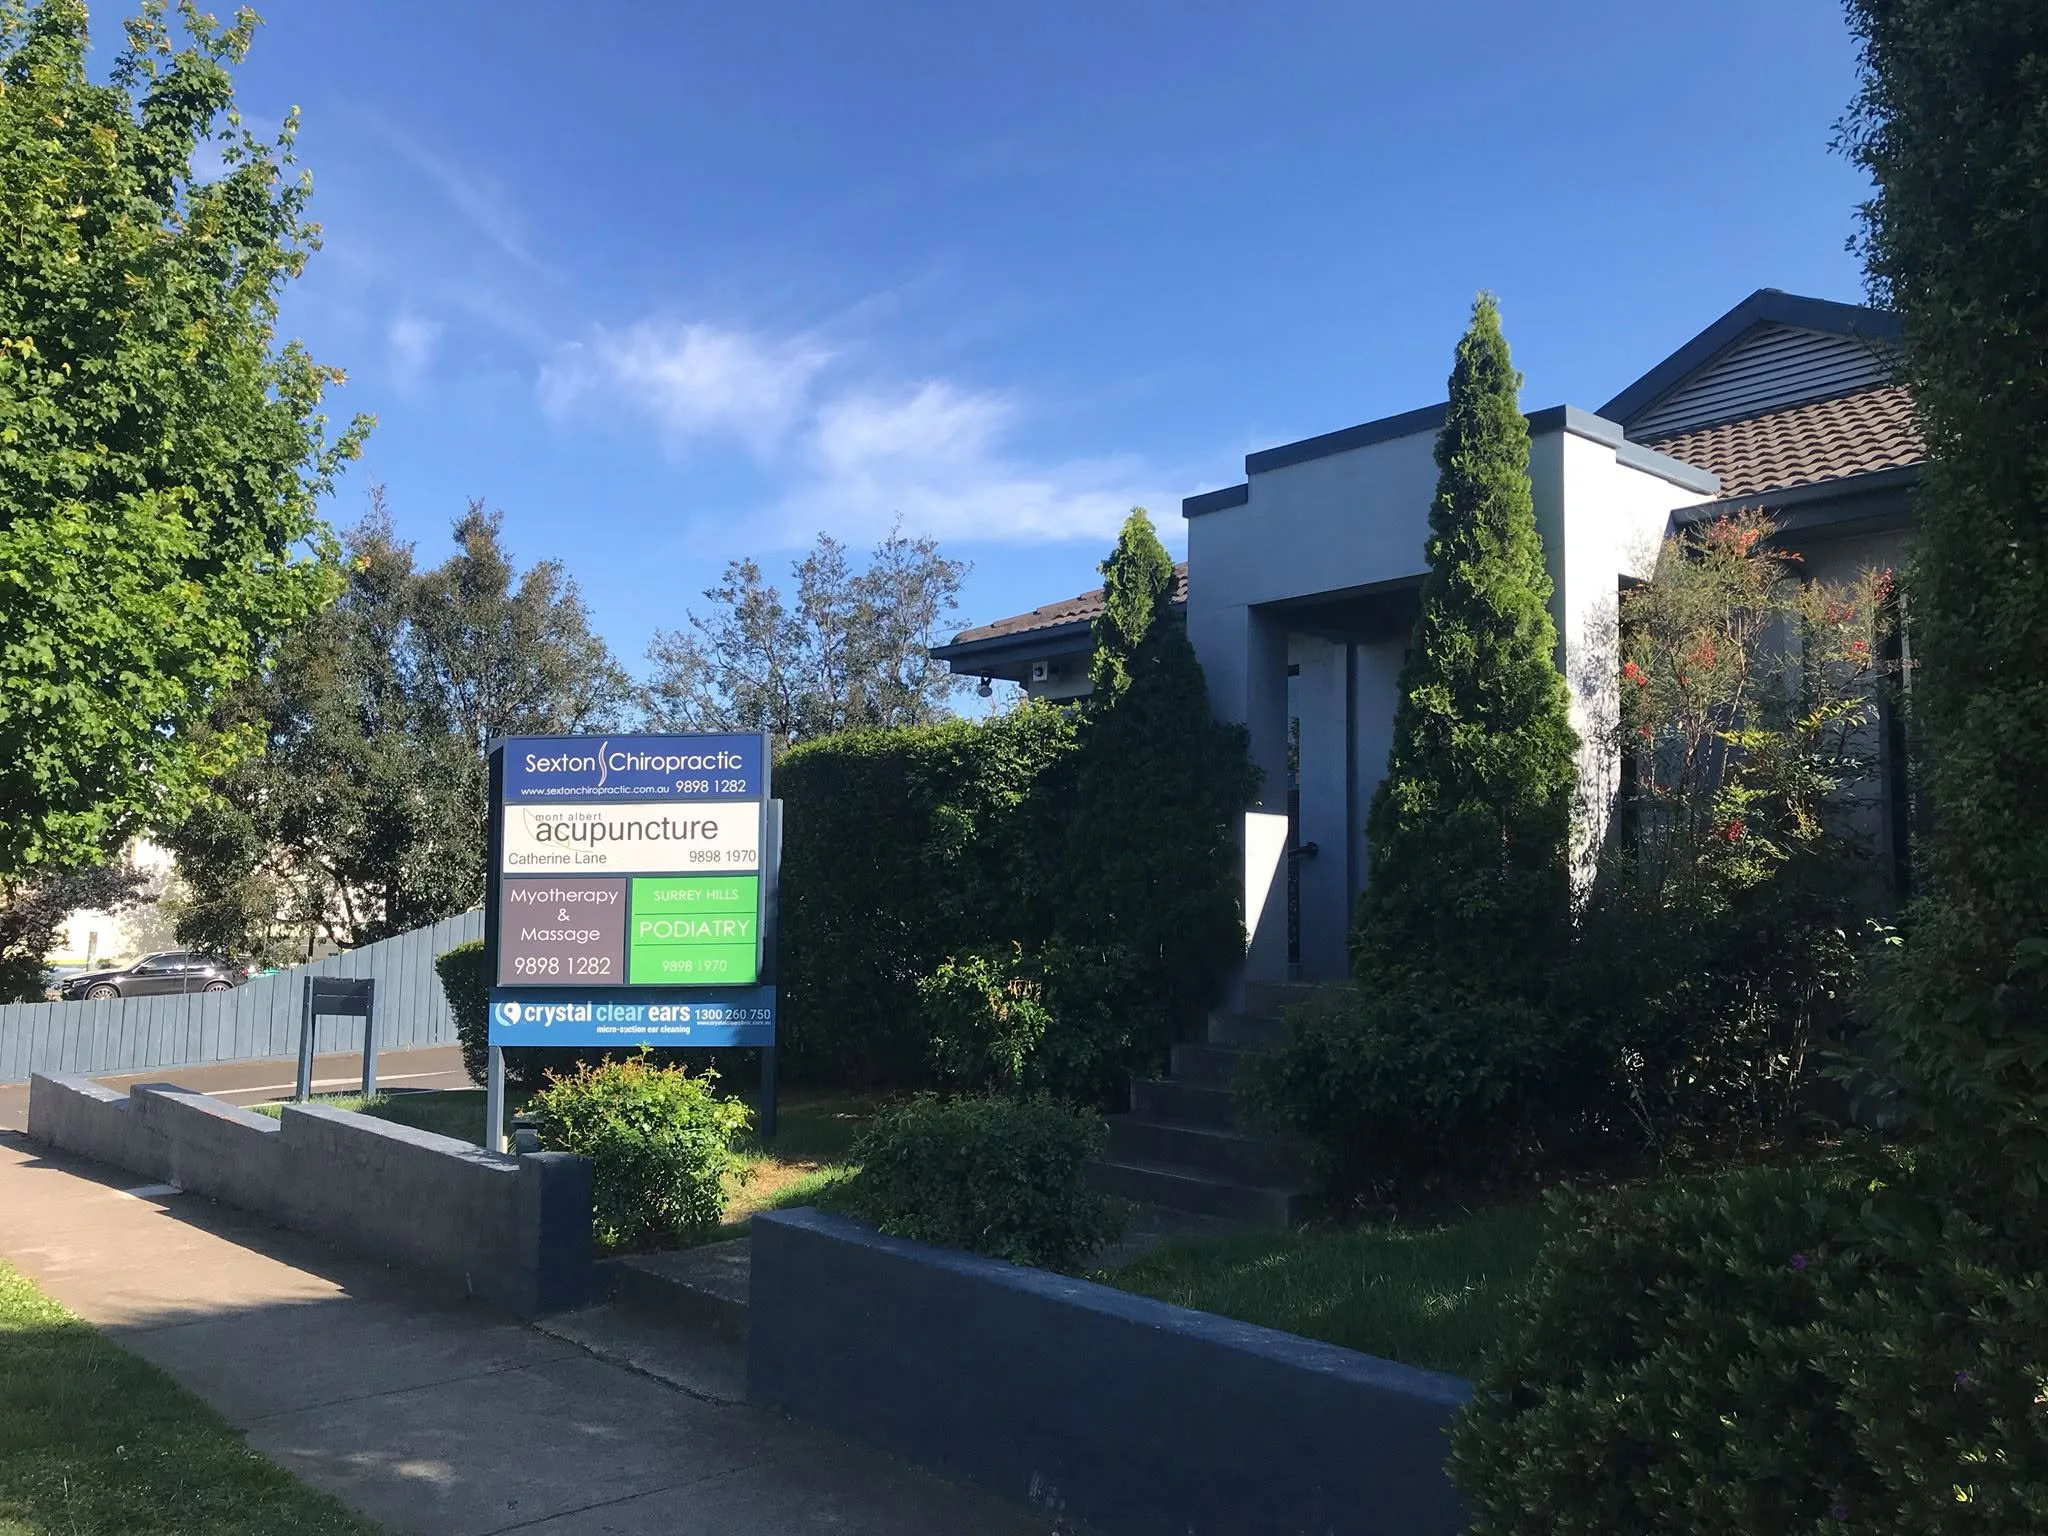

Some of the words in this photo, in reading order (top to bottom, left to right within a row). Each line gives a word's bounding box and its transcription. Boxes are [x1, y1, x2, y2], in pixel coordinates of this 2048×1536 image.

[525, 754, 595, 772] Sexton
[608, 750, 742, 774] Chiropractic
[521, 786, 670, 795] www.sextonchiropractic.com.au
[675, 780, 709, 793] 9898
[713, 780, 746, 793] 1282
[535, 814, 563, 822] mont
[568, 812, 602, 821] albert
[535, 817, 718, 847] acupuncture
[508, 852, 571, 866] Catherine
[575, 851, 607, 865] Lane
[689, 851, 721, 863] 9898
[726, 850, 757, 862] 1970
[510, 888, 619, 905] Myotherapy
[654, 890, 702, 901] SURREY
[706, 889, 739, 900] HILLS
[557, 908, 570, 922] &
[520, 927, 600, 944] Massage
[640, 920, 751, 938] PODIATRY
[514, 957, 560, 975] 9898
[567, 957, 611, 975] 1282
[662, 961, 692, 972] 9898
[698, 960, 727, 971] 1970
[525, 1001, 592, 1027] crystal
[596, 1000, 644, 1022] clear
[648, 1005, 690, 1022] ears
[695, 1009, 723, 1020] 1300
[726, 1009, 748, 1020] 260
[750, 1009, 771, 1020] 750
[596, 1024, 646, 1034] micro-suction
[648, 1026, 660, 1034] ear
[661, 1024, 691, 1035] cleaning
